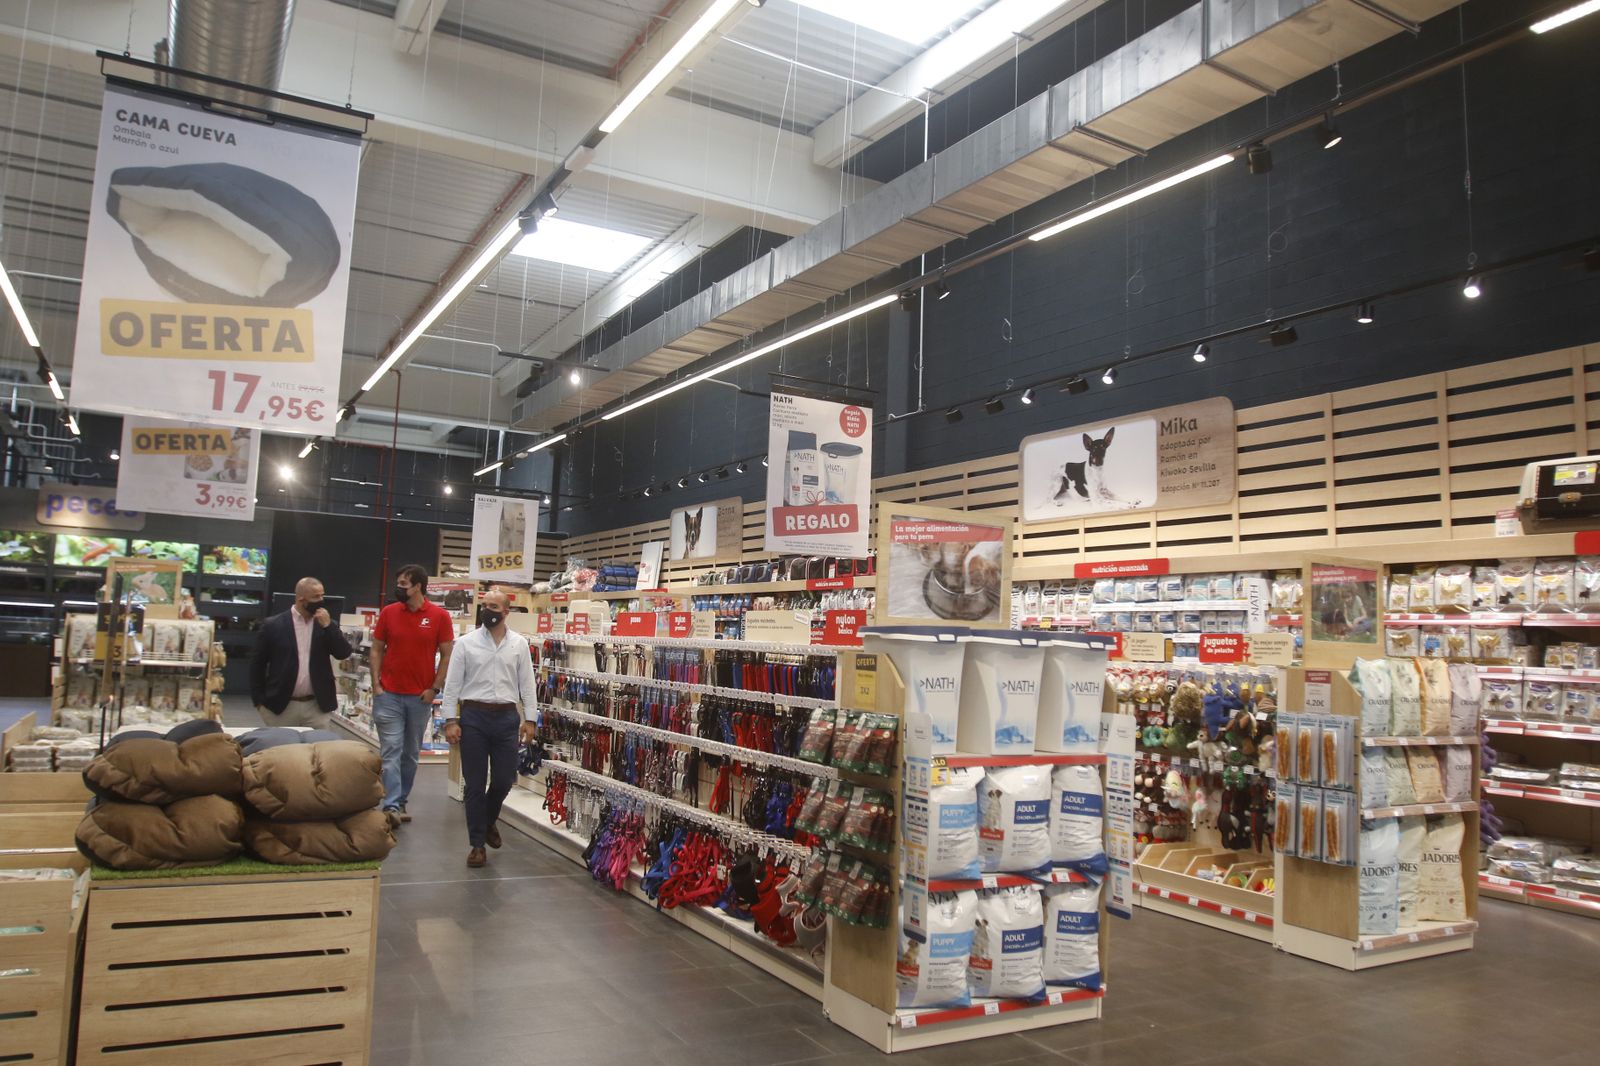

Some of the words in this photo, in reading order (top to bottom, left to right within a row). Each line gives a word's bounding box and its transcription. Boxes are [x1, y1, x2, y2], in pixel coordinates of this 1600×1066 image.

[115, 109, 171, 132] CAMA
[178, 122, 237, 146] CUEVA
[112, 134, 148, 148] Marrón
[149, 142, 157, 150] o
[158, 144, 180, 154] azul
[109, 311, 305, 353] OFERTA
[207, 369, 326, 422] 17,95€
[773, 395, 794, 405] NATH
[1160, 417, 1199, 436] Mika
[135, 432, 227, 450] OFERTA
[1160, 438, 1197, 450] adoptada
[1199, 435, 1212, 448] por
[798, 453, 815, 462] NATH
[1189, 462, 1217, 473] Sevilla
[195, 483, 248, 509] 3,99€
[785, 513, 850, 530] REGALO
[905, 525, 926, 535] mejor
[926, 524, 969, 533] alimentación
[895, 534, 909, 543] para
[478, 554, 523, 570] 15,95€
[1091, 564, 1118, 574] nutrición
[1118, 563, 1149, 572] avanzada
[1249, 584, 1260, 617] NATH
[835, 614, 856, 628] nylon
[1203, 636, 1238, 648] juguetes
[856, 658, 876, 666] OFERTA
[925, 677, 955, 690] NATH
[1007, 680, 1034, 692] NATH
[1075, 681, 1099, 693] NATH
[1064, 796, 1086, 804] ADULT
[1060, 915, 1083, 924] ADULT
[932, 938, 956, 946] PUPPY
[1005, 933, 1026, 942] ADULT
